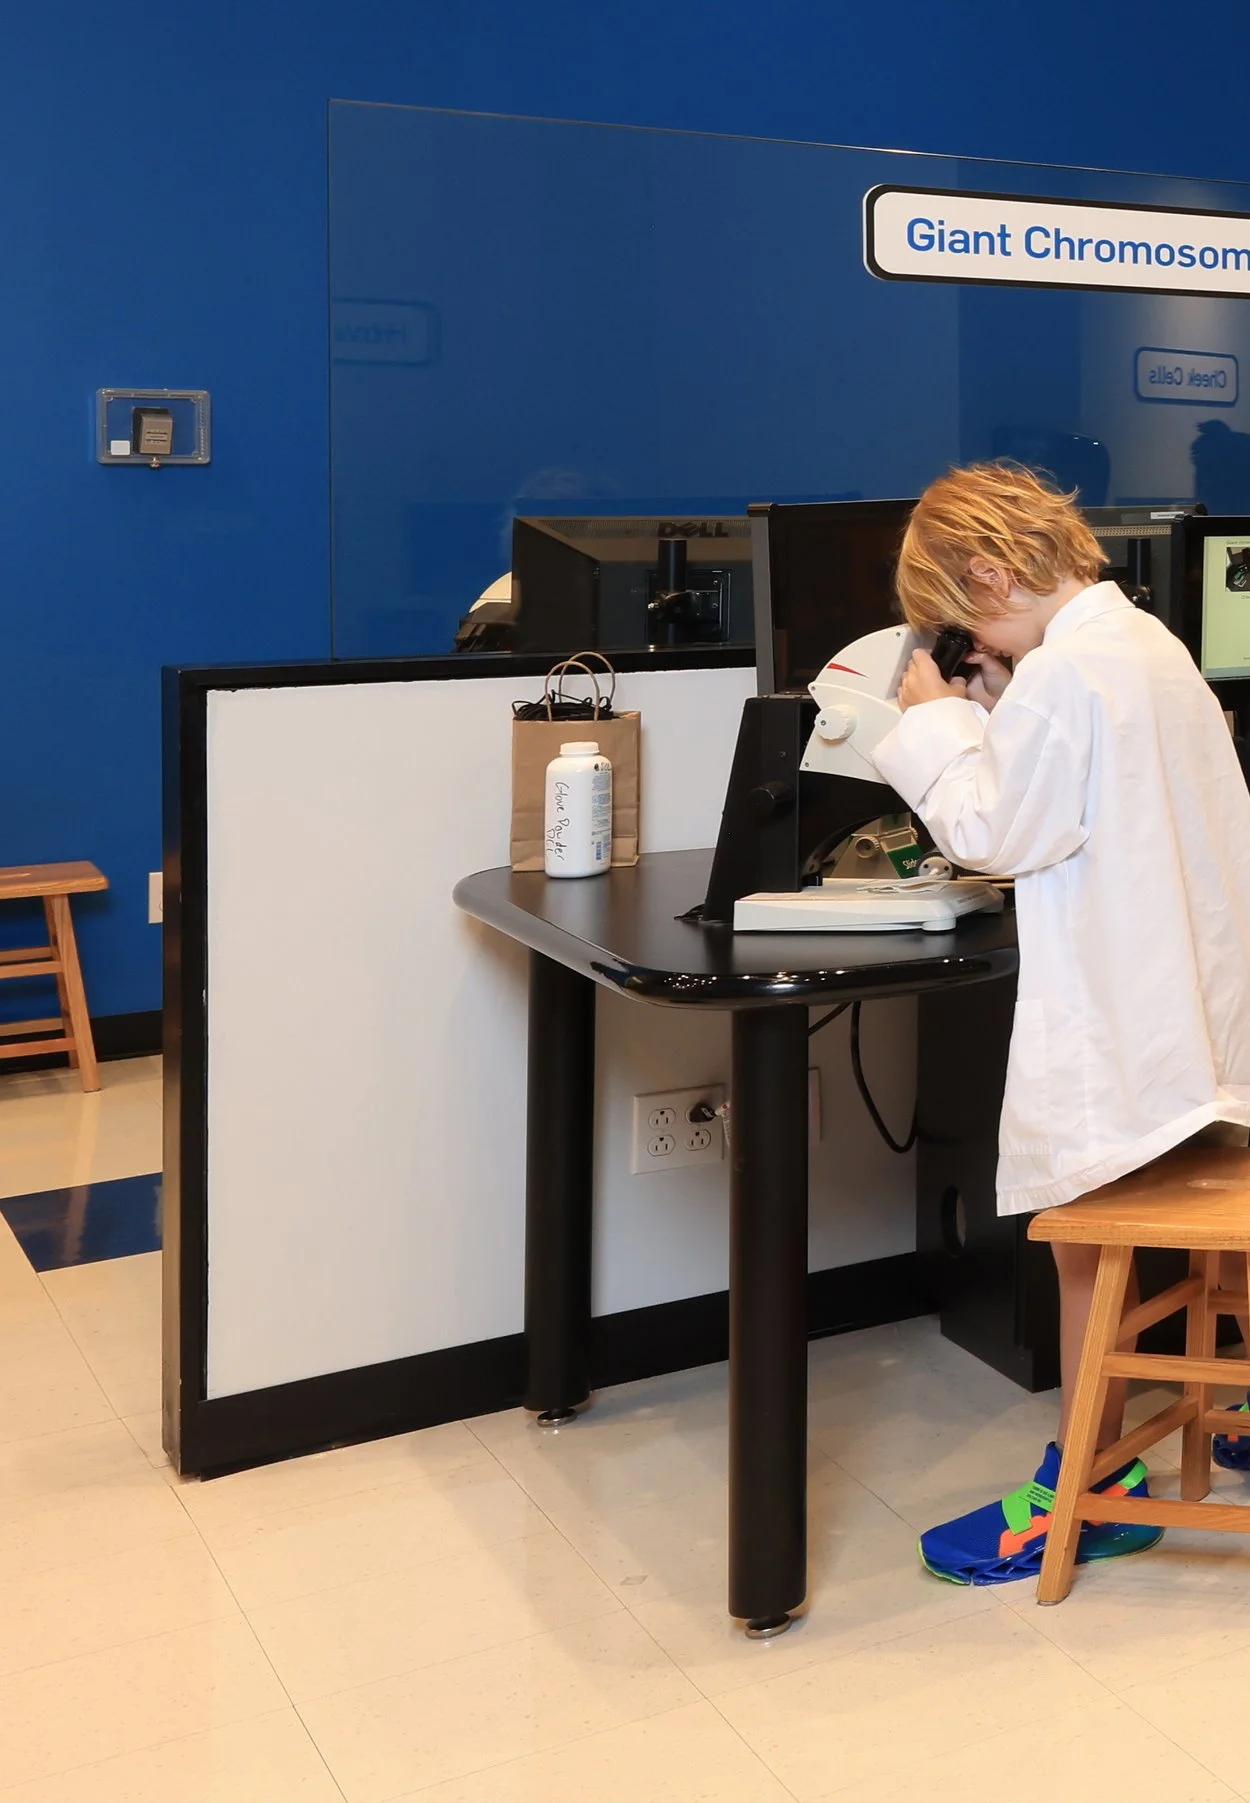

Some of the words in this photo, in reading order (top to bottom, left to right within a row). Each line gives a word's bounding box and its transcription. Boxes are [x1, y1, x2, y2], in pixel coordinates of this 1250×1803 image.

[906, 217, 1012, 258] Giant
[657, 521, 729, 538] DELL
[555, 781, 570, 813] Glove
[554, 817, 570, 861] Powder
